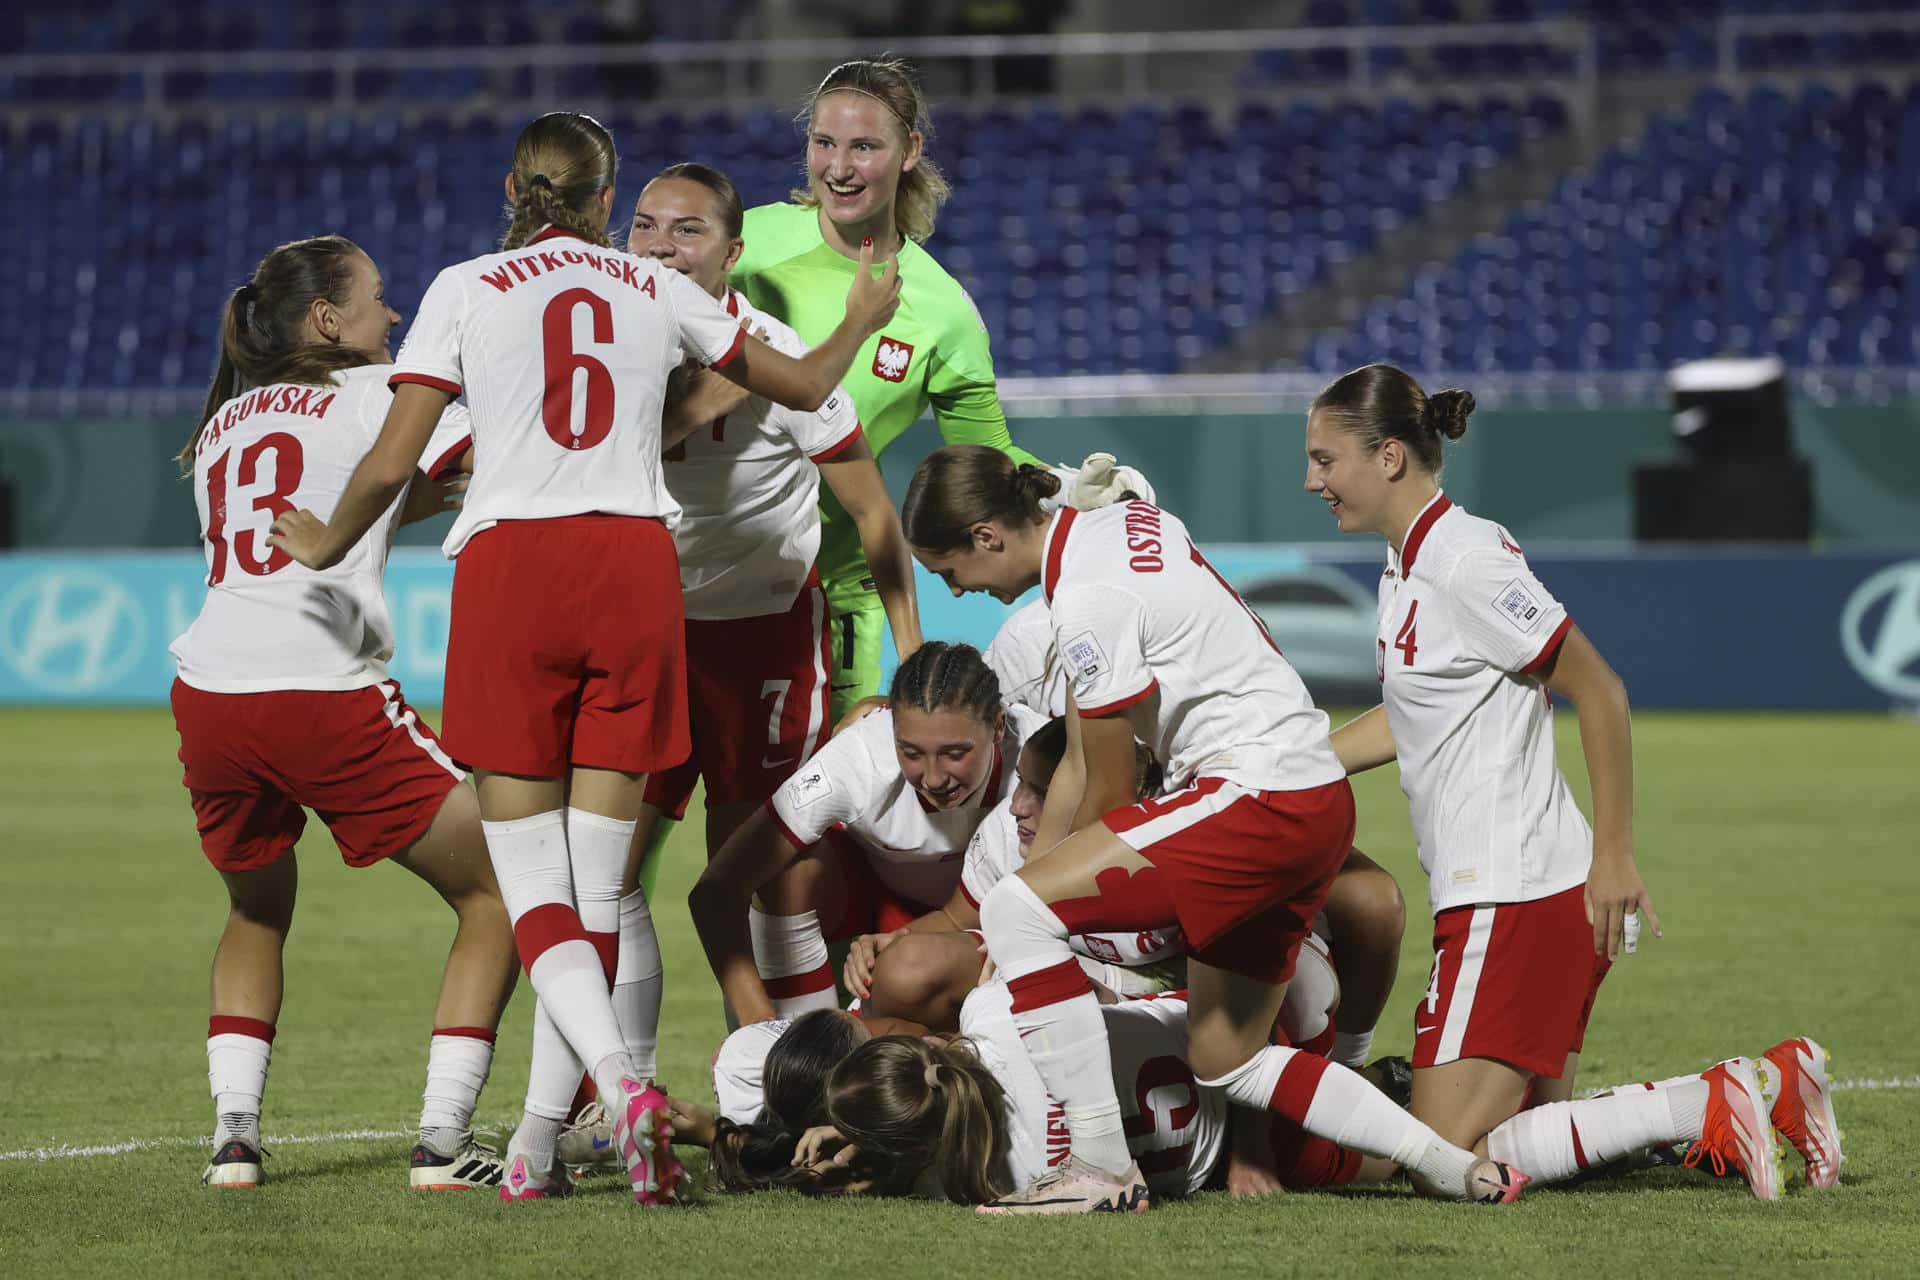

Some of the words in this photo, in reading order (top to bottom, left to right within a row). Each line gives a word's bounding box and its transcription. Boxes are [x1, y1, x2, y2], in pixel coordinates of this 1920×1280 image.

[480, 250, 657, 301] WITKOWSKA
[541, 287, 616, 452] 6
[206, 431, 305, 588] 13
[839, 612, 855, 670] 1
[1394, 599, 1418, 667] 4
[760, 680, 793, 745] 7
[1426, 948, 1446, 1014] 4
